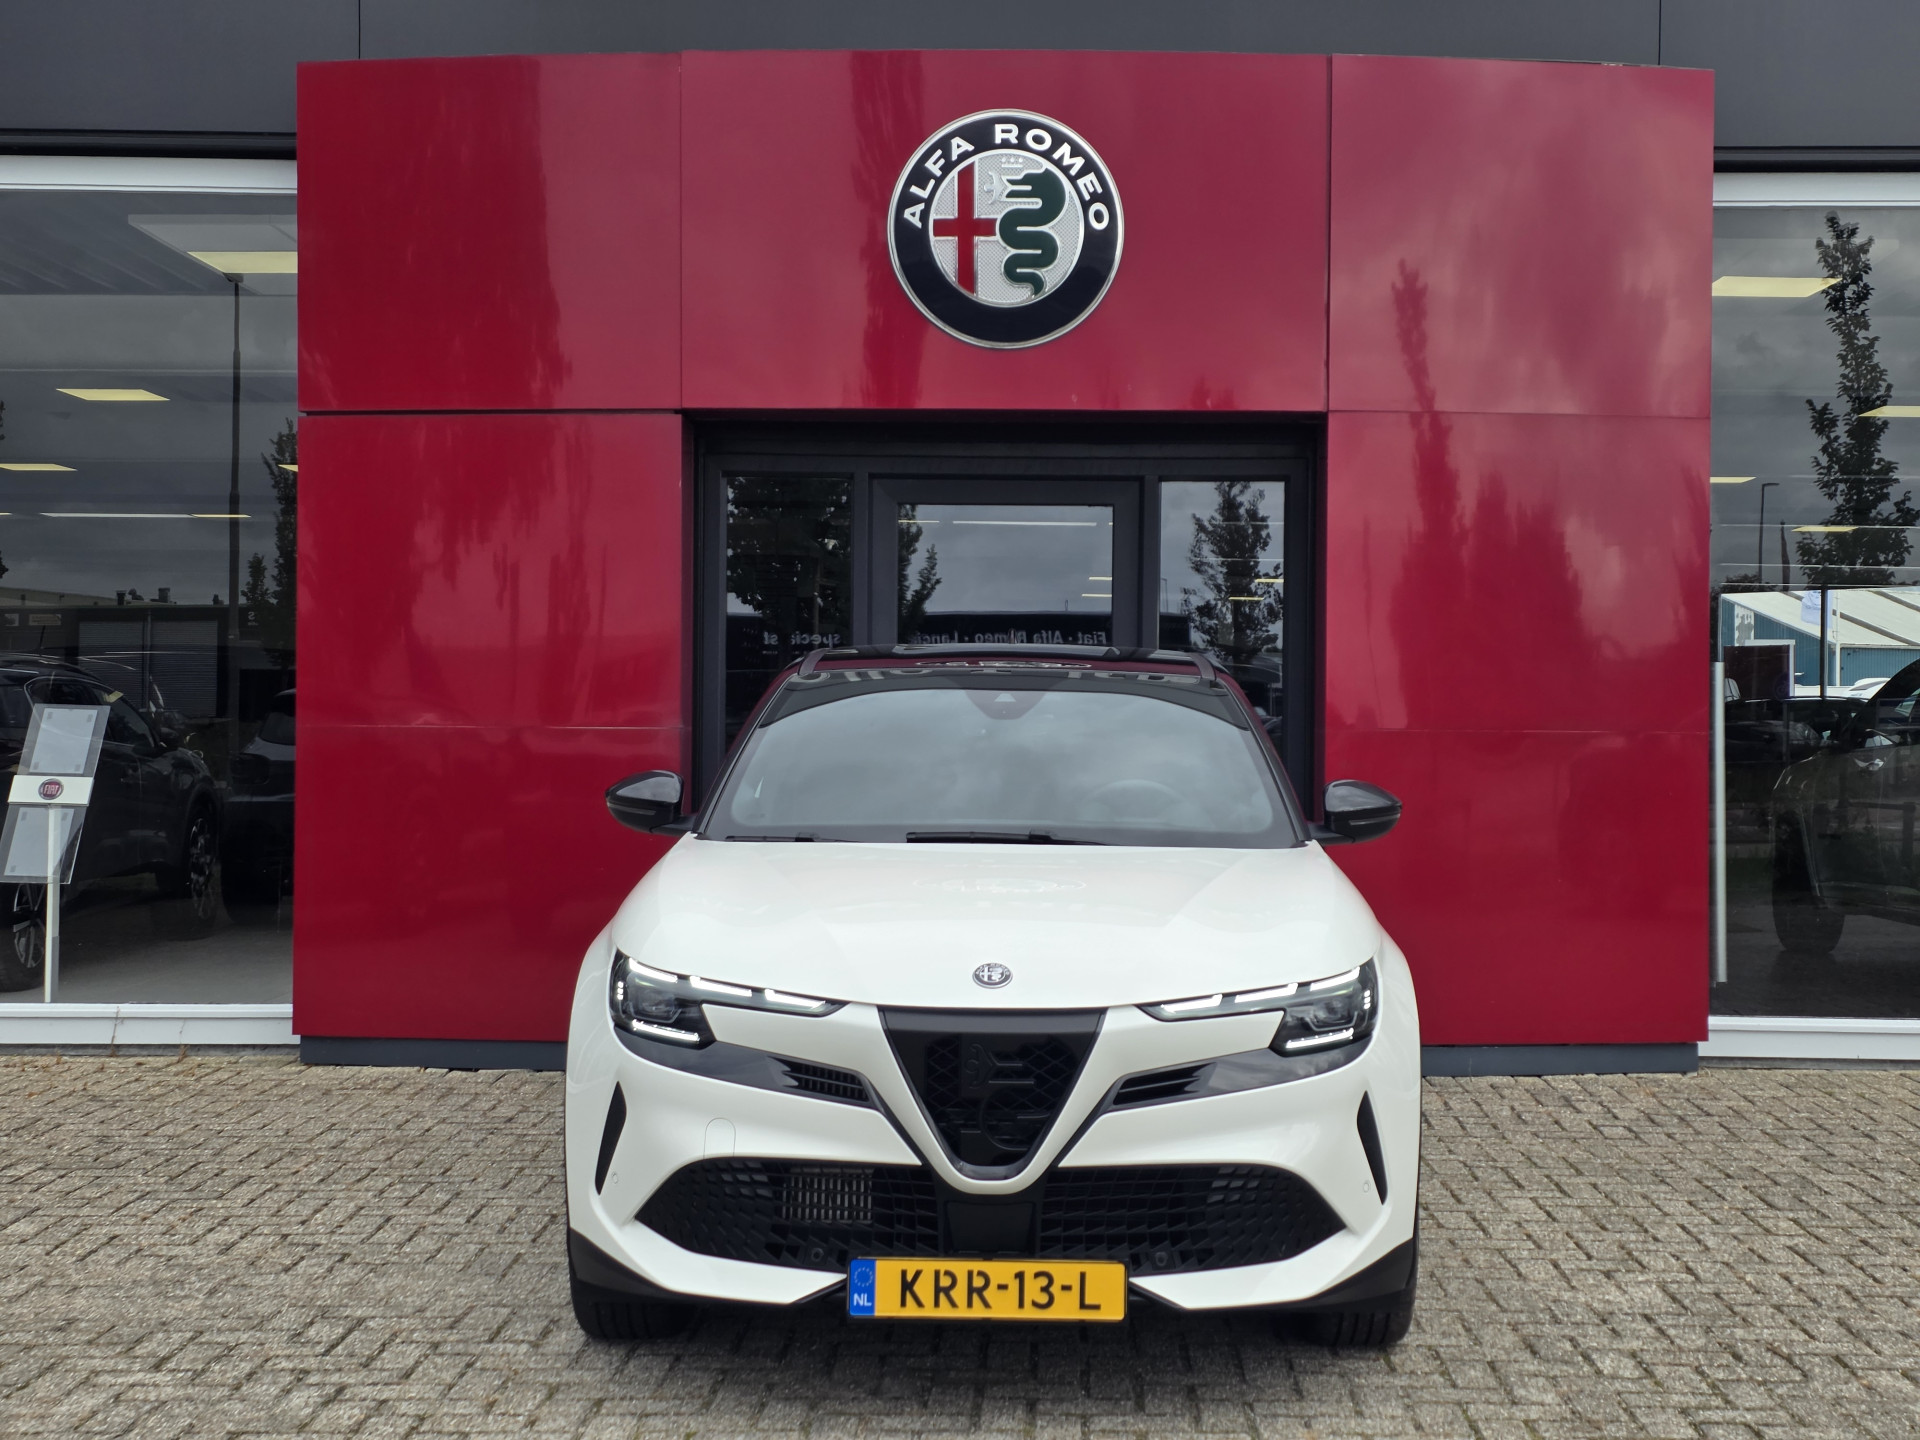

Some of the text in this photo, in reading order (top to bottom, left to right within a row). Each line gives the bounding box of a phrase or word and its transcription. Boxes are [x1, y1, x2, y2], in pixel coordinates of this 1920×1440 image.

[903, 123, 1110, 231] ALFA ROMEO
[43, 784, 60, 795] FIAT
[853, 1293, 872, 1307] NL
[900, 1268, 1102, 1311] KRR-13-L
